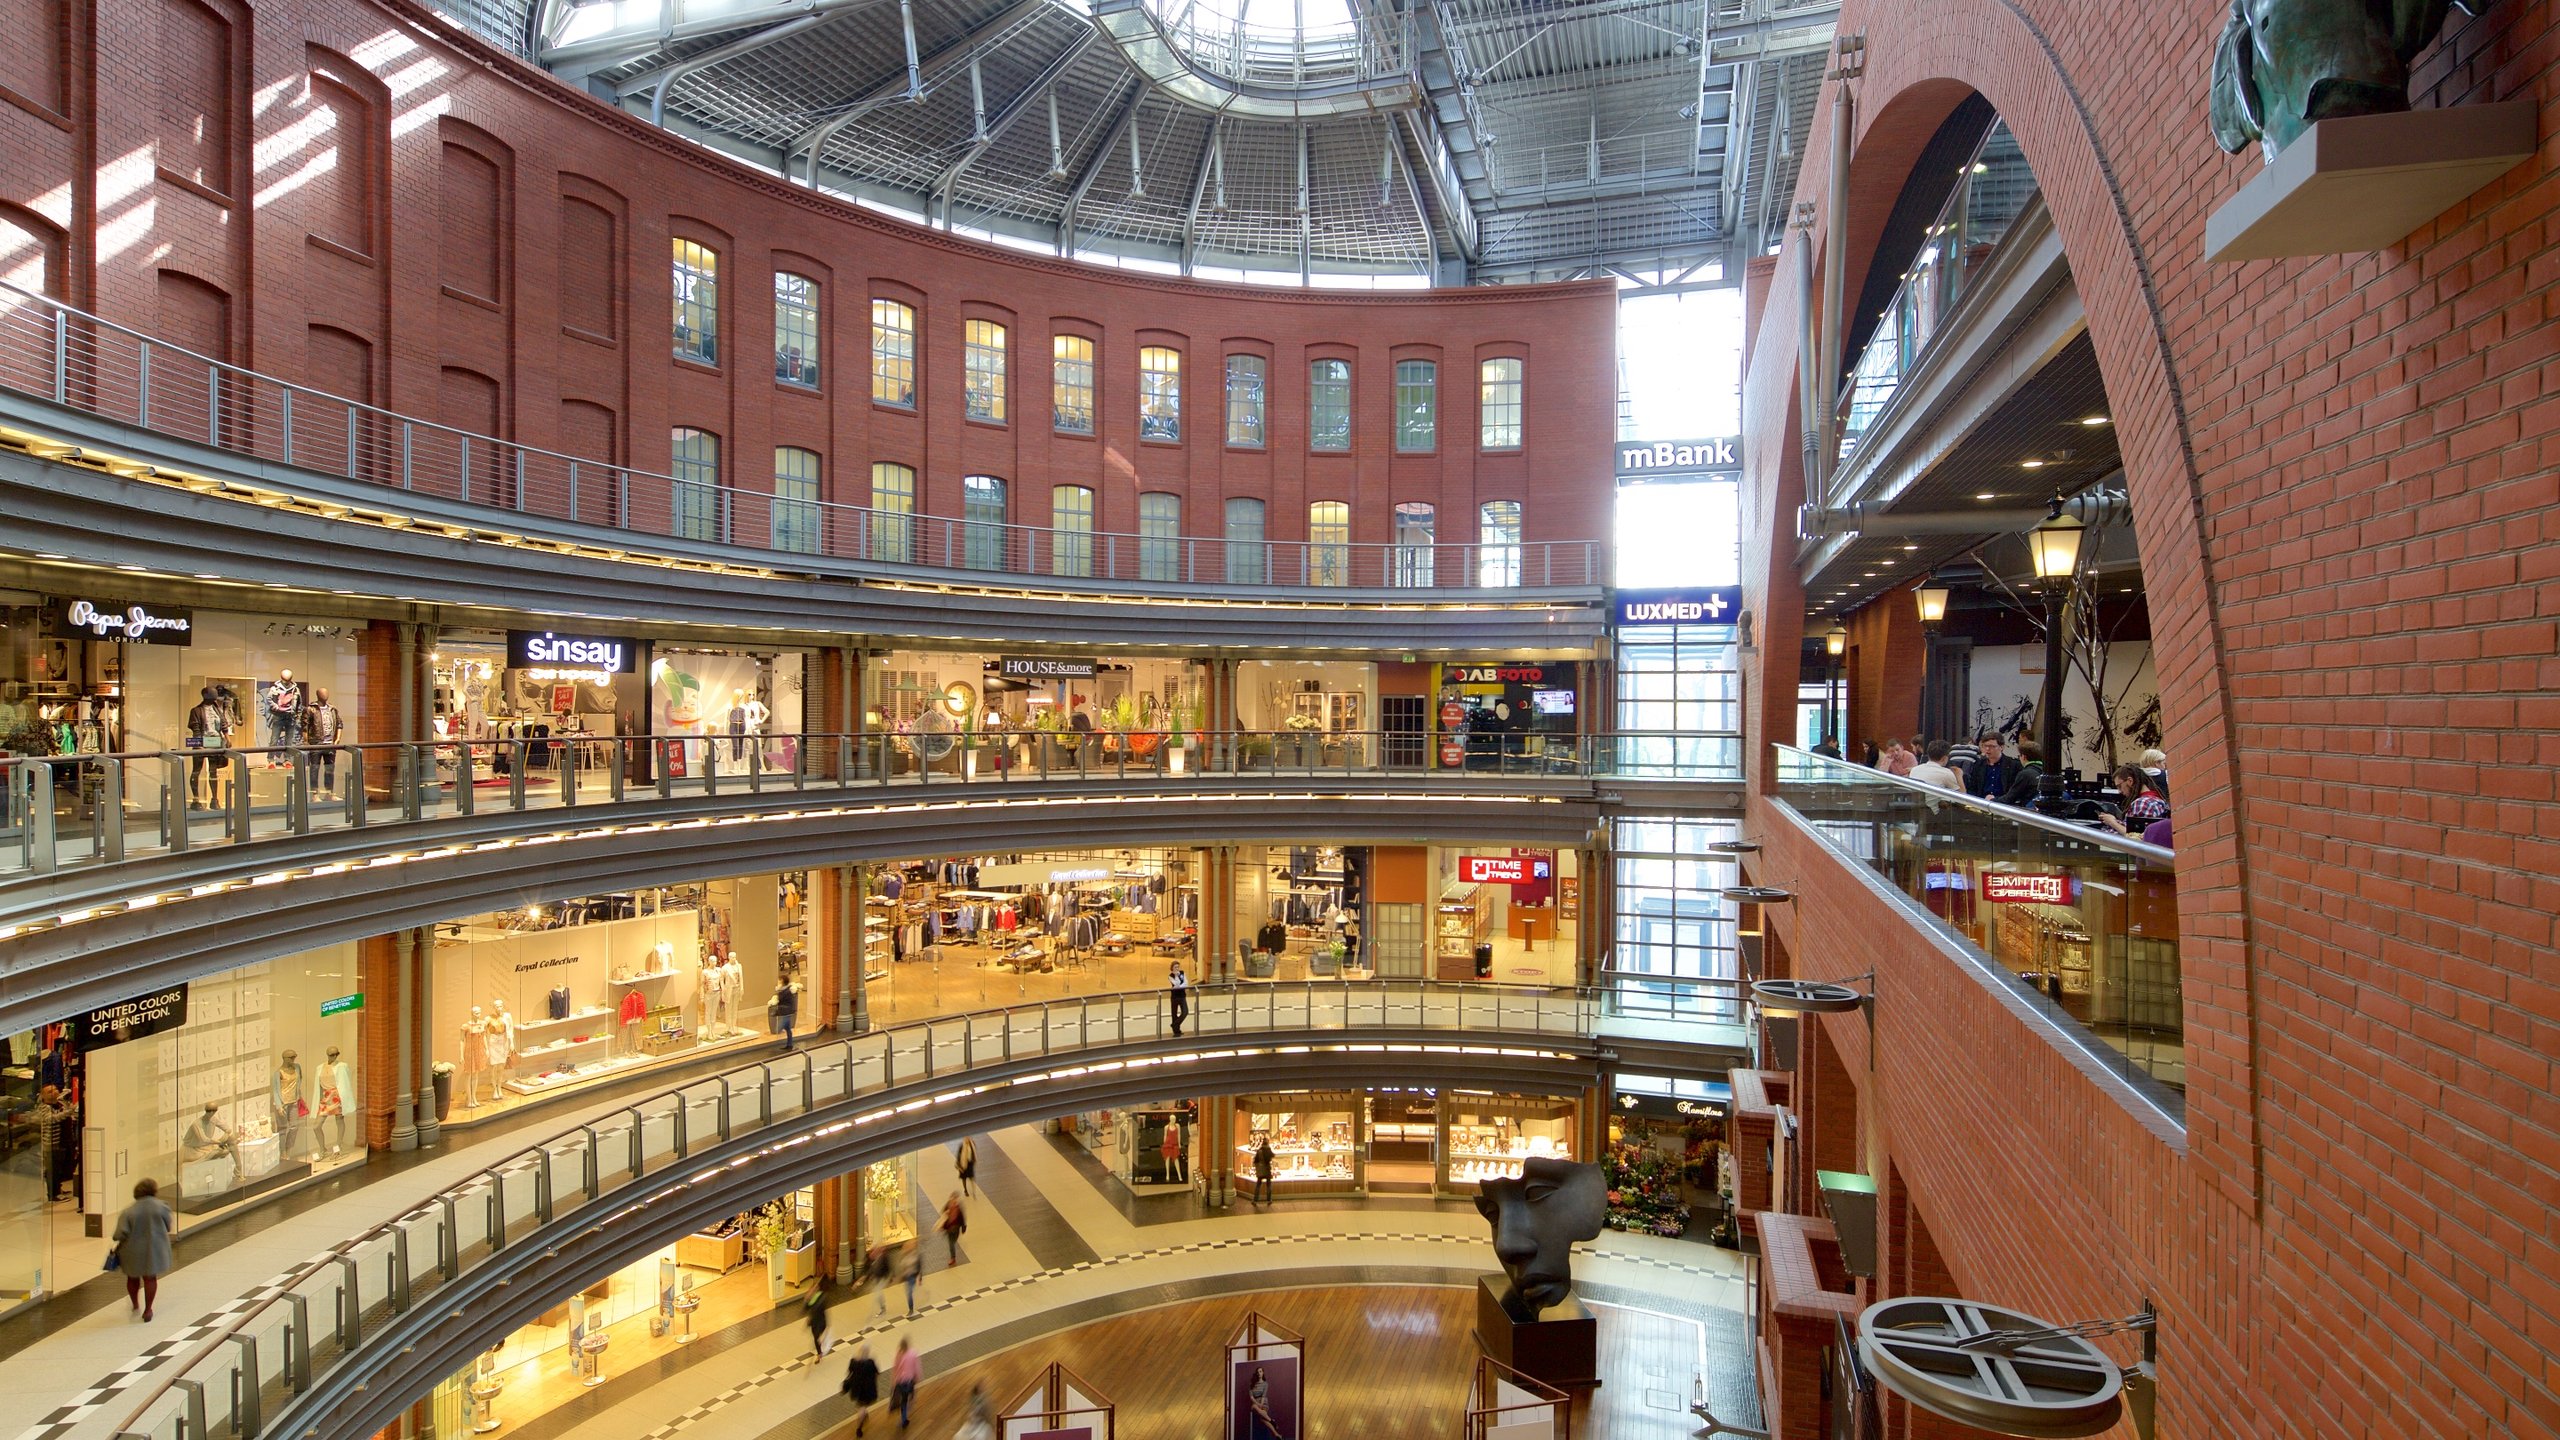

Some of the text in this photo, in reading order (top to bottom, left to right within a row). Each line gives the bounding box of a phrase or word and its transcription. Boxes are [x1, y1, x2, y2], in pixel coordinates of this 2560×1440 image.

[1623, 438, 1735, 468] mBank
[71, 601, 189, 637] Pepe Jeans
[1627, 603, 1702, 620] LUXMED
[109, 636, 149, 644] LONDON
[527, 632, 621, 672] sinsay
[1489, 860, 1522, 870] TIME
[1490, 871, 1522, 879] TREND
[515, 956, 579, 973] Royal Collection
[91, 991, 181, 1023] UNITED COLORS
[90, 1021, 109, 1035] OF
